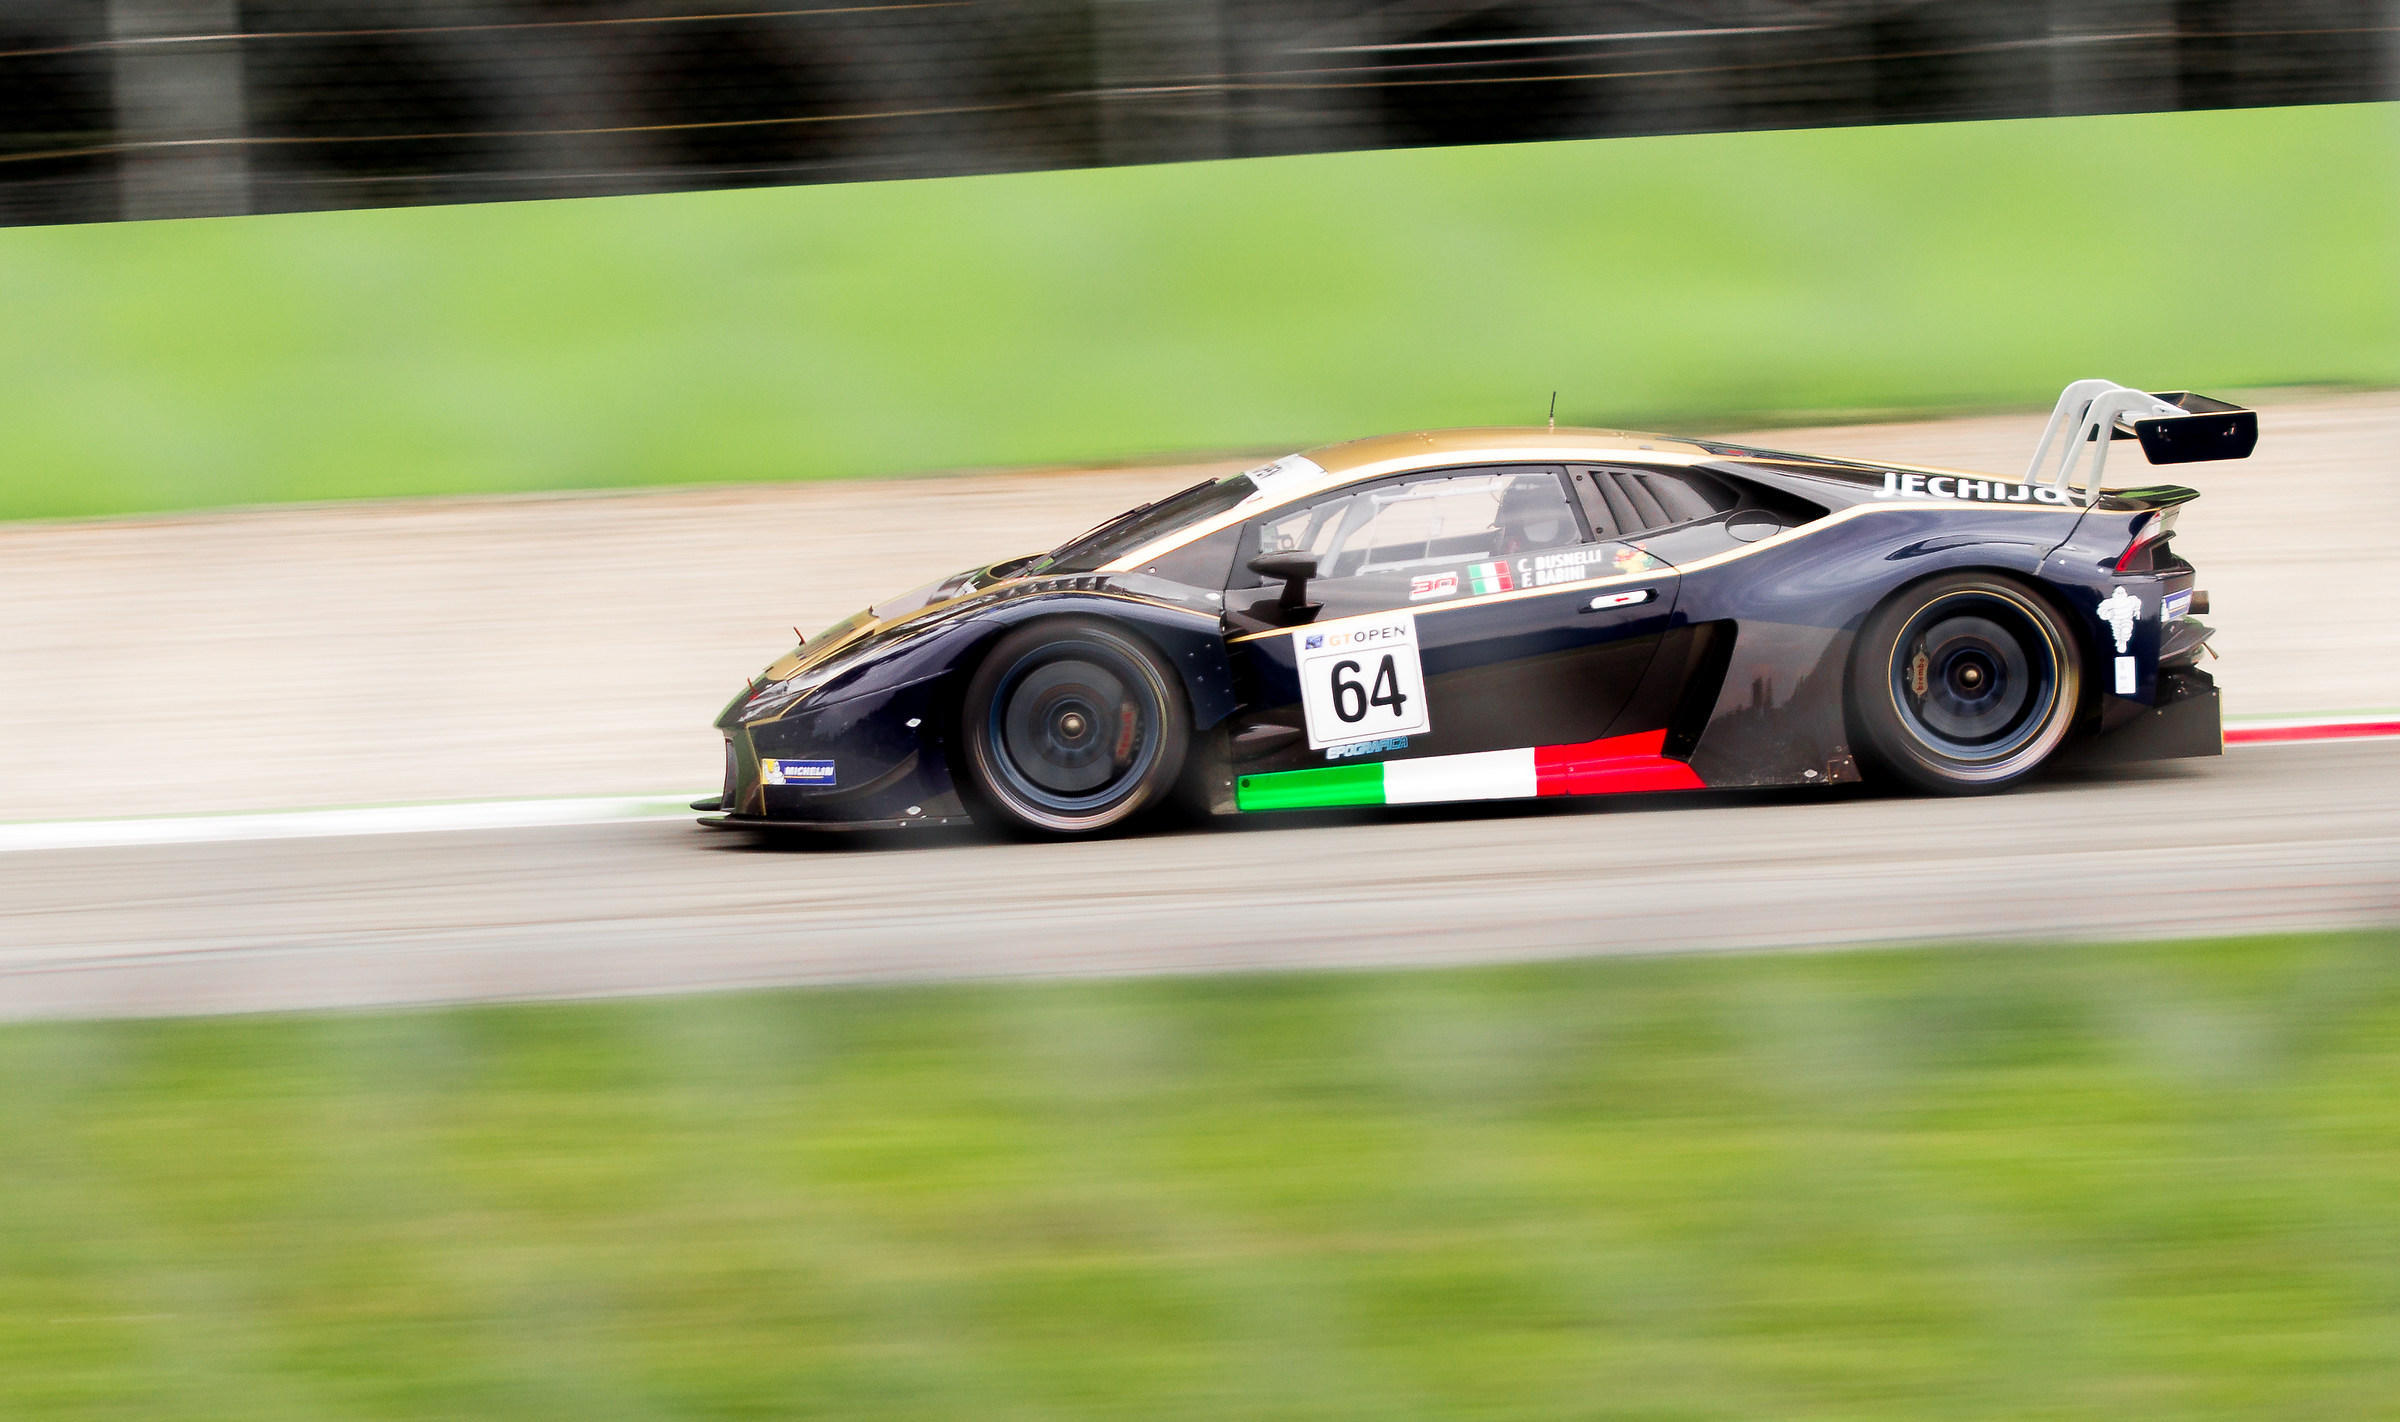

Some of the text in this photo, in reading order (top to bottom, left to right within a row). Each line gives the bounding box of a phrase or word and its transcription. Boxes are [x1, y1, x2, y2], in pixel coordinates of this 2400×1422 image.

[1535, 564, 1585, 586] BABINI
[1331, 654, 1407, 723] 64
[784, 766, 835, 776] MICHELIN
